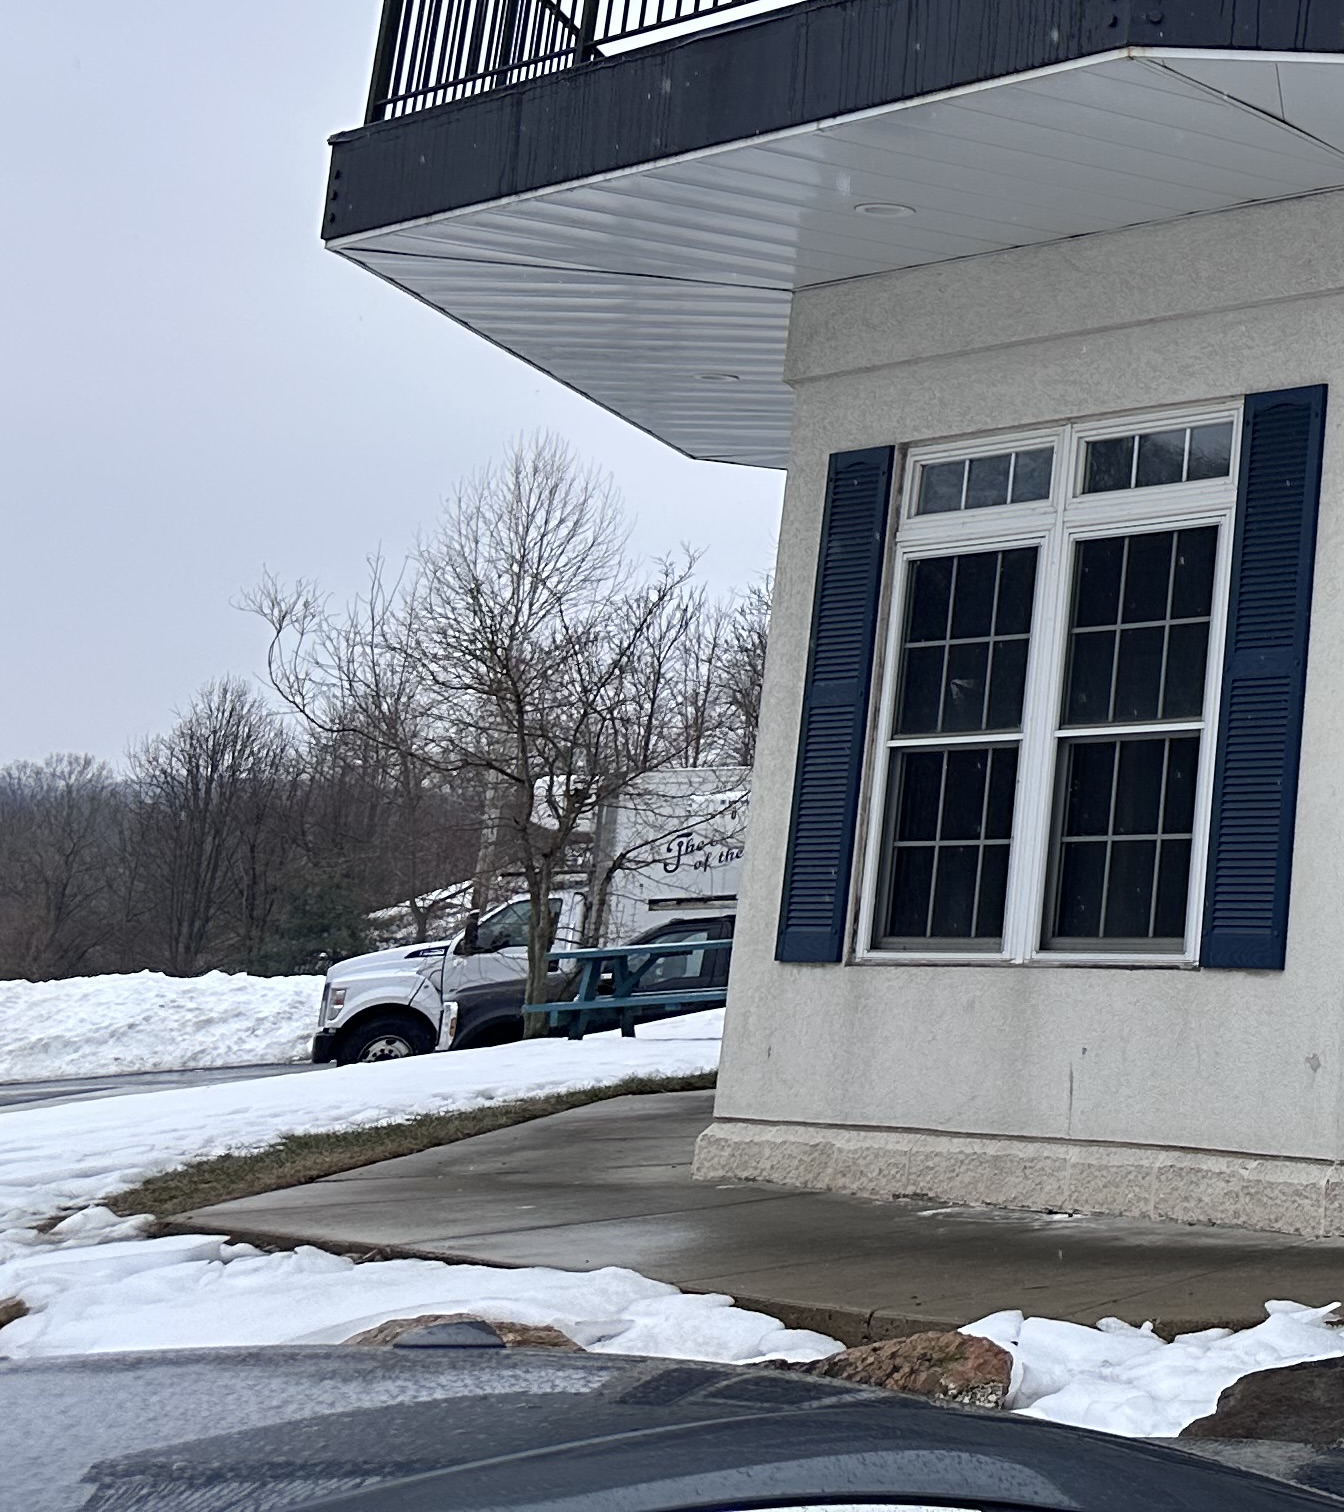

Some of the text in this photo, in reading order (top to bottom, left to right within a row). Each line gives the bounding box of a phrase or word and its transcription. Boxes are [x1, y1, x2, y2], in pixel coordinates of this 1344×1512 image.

[663, 832, 705, 873] The
[694, 848, 744, 872] of the
